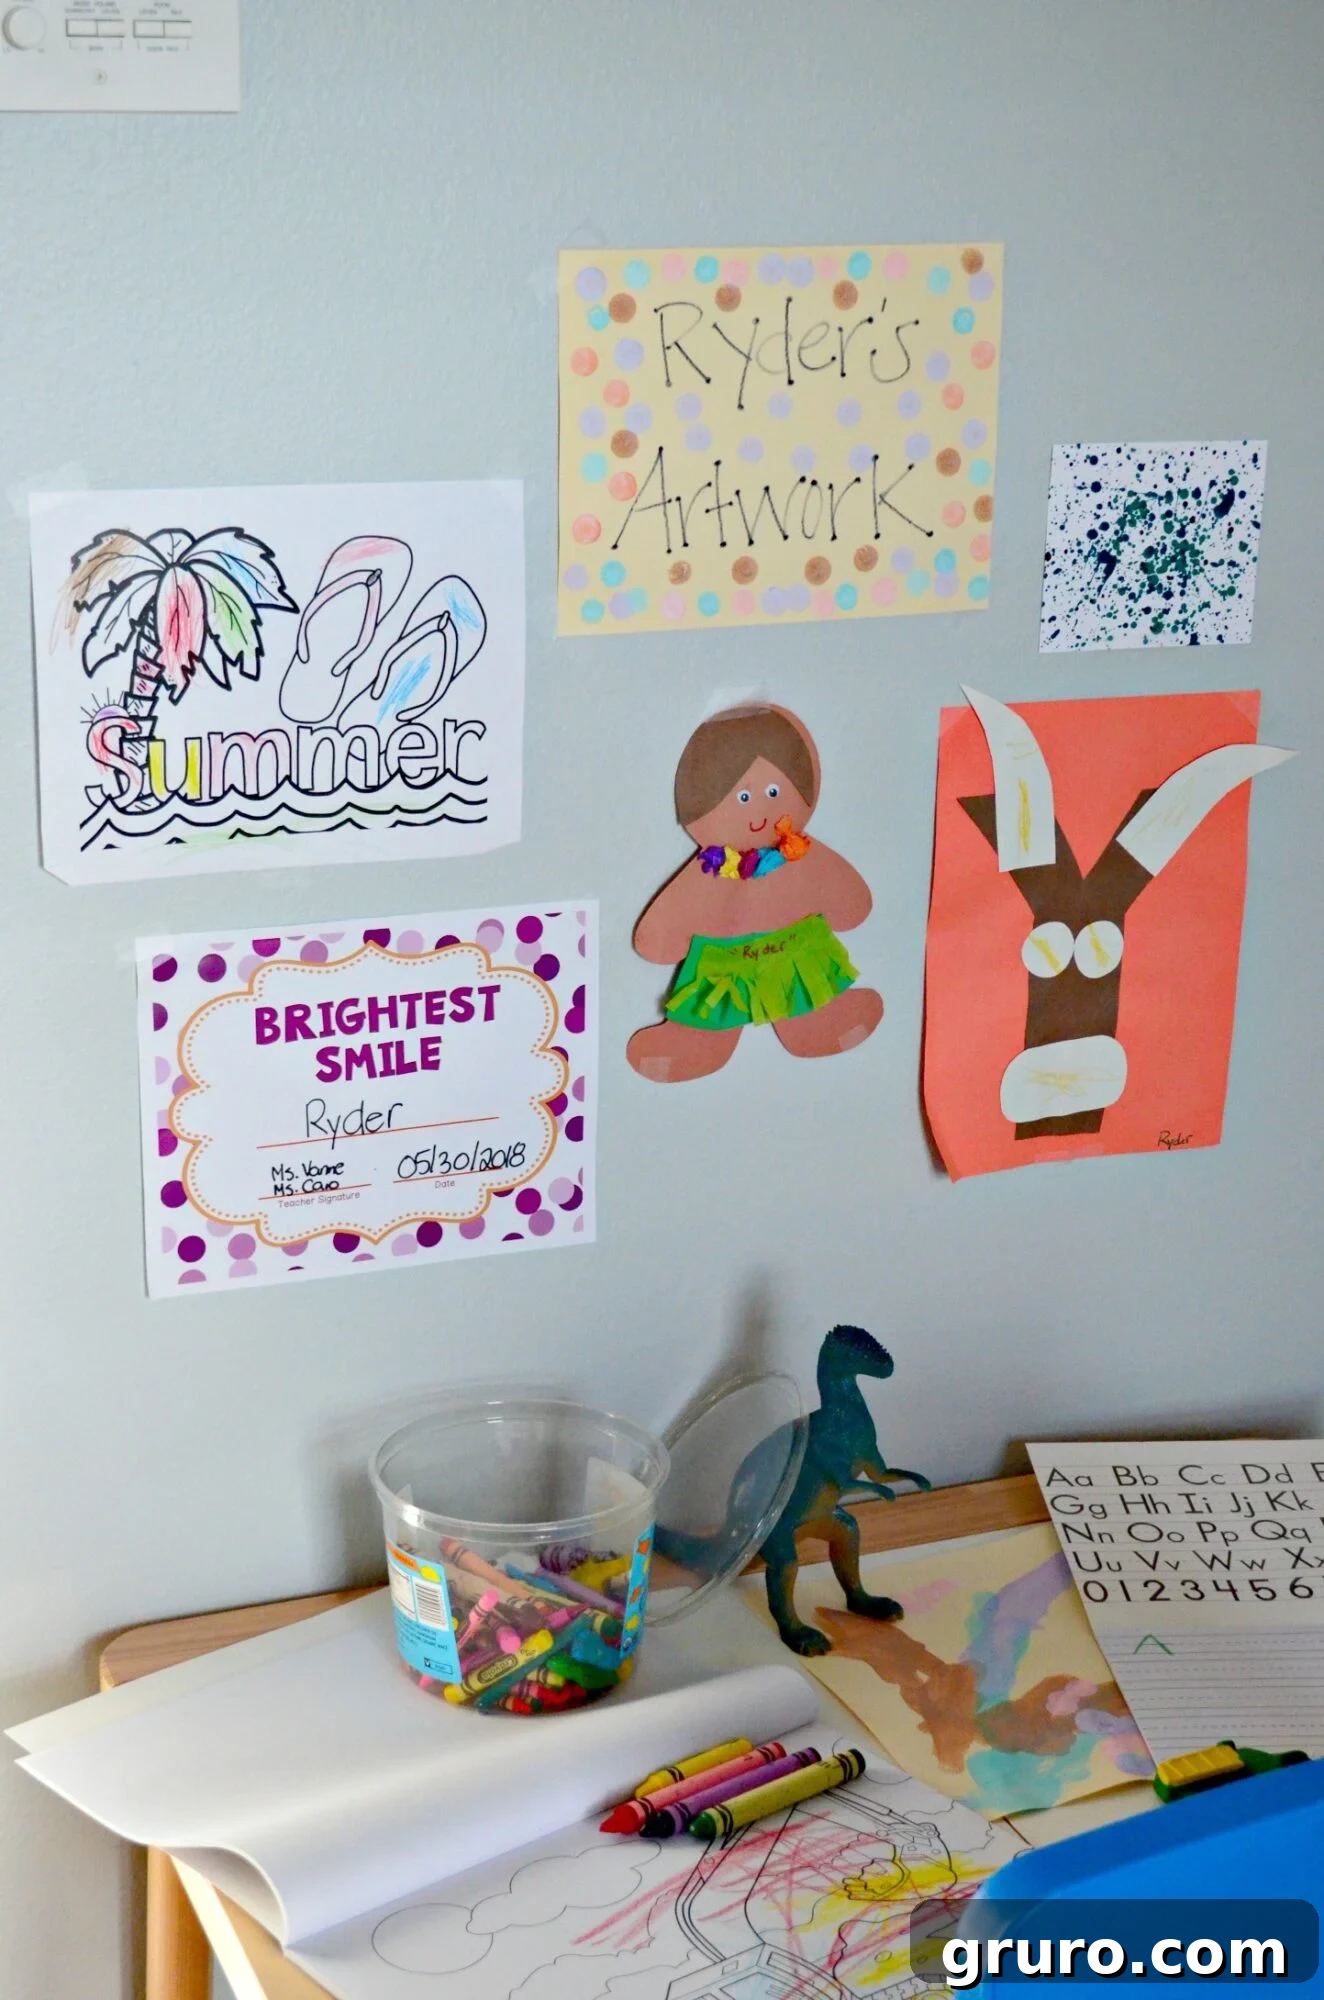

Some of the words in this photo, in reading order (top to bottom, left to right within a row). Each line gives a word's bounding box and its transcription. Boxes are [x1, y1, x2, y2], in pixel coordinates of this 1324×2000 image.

[654, 297, 920, 410] Ryder's
[612, 446, 935, 554] Artwork
[85, 715, 486, 810] Summer
[255, 984, 501, 1045] BRIGHTEST
[315, 1036, 442, 1083] SMILE
[305, 1098, 403, 1149] Ryder
[1158, 1130, 1194, 1150] Ryder
[271, 1163, 299, 1181] Ms.
[397, 1140, 526, 1179] 05/30/2018
[273, 1183, 298, 1197] Ms.
[434, 1179, 456, 1189] Date
[278, 1197, 315, 1208] Teacher
[317, 1191, 361, 1205] Signature
[1045, 1467, 1094, 1487] Aa
[1112, 1465, 1159, 1487] Bb
[1177, 1464, 1226, 1486] Cc
[1240, 1463, 1294, 1485] Dd
[1049, 1494, 1108, 1520] Gg
[1118, 1493, 1171, 1515] Hh
[1177, 1492, 1213, 1514] Ii
[1230, 1492, 1255, 1518] Jj
[1265, 1491, 1314, 1512] Kk
[1060, 1522, 1115, 1544] Nn
[1127, 1521, 1185, 1544] Oo
[1195, 1521, 1239, 1547] Pp
[1250, 1519, 1312, 1543] Qq
[1072, 1551, 1122, 1573] Uu
[1133, 1551, 1181, 1572] Vv
[1192, 1550, 1266, 1571] Ww
